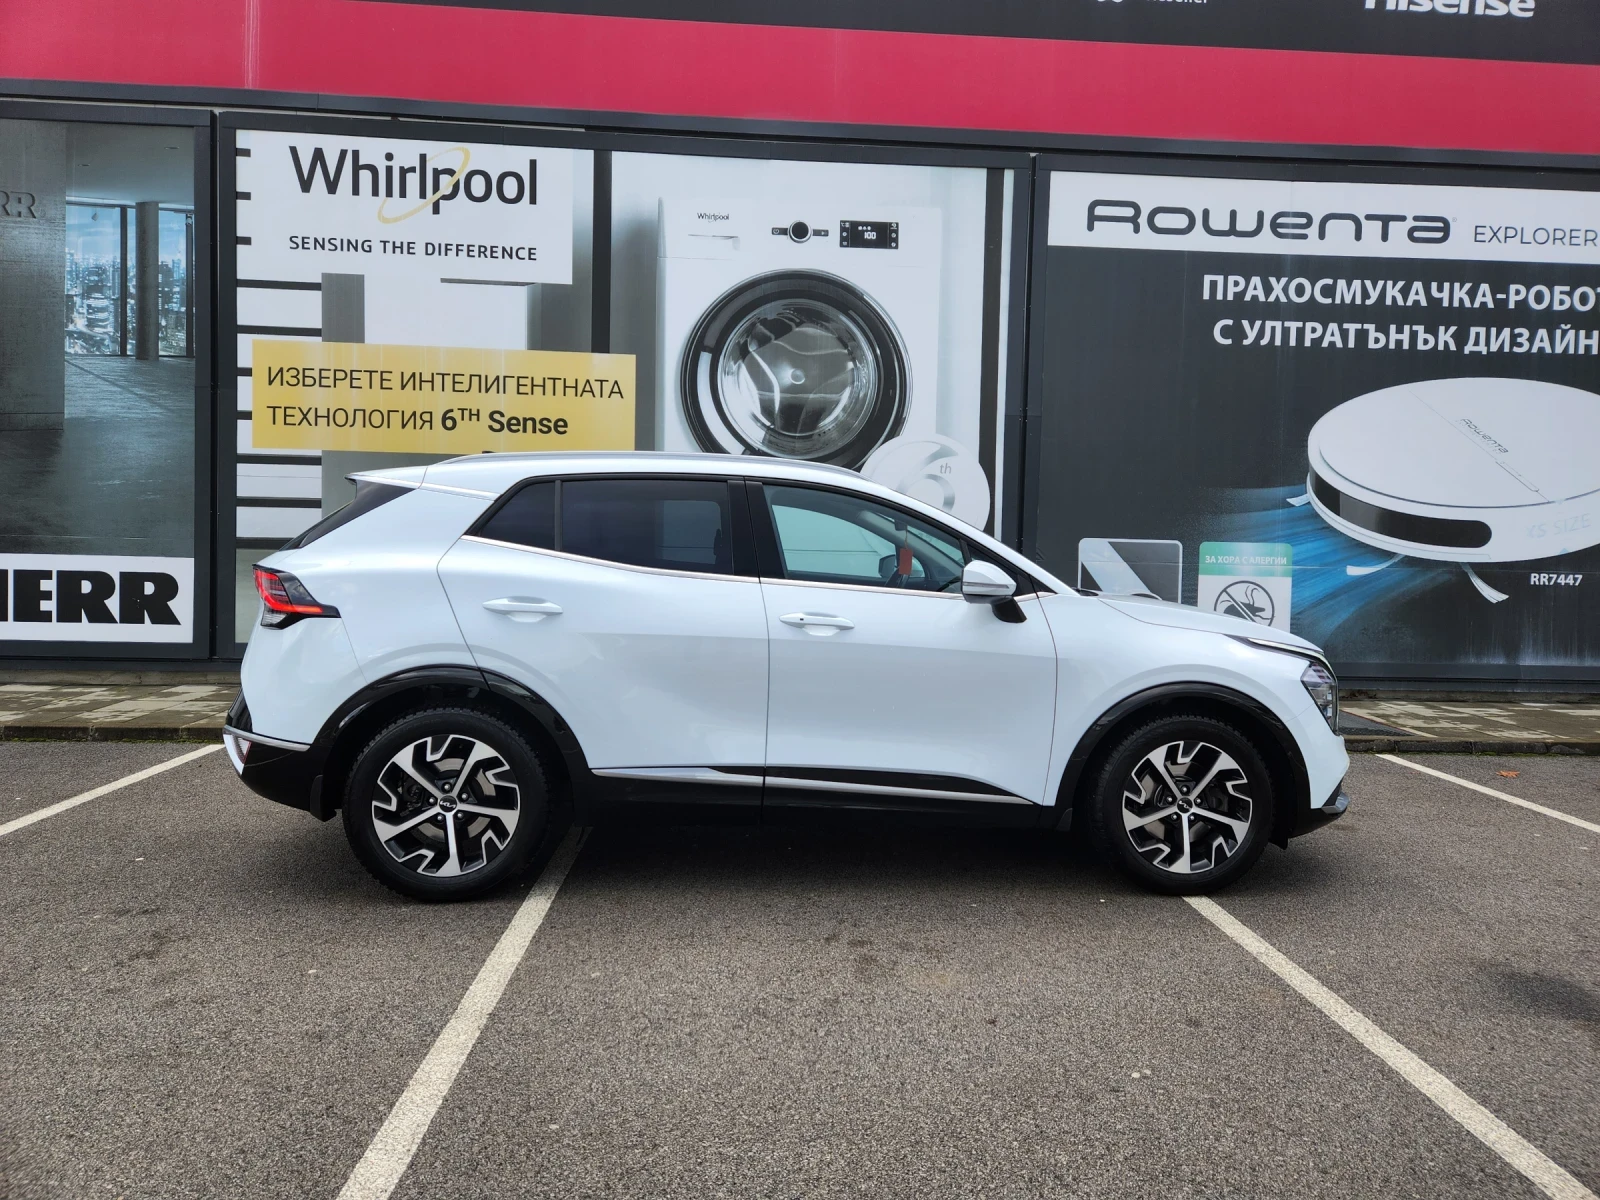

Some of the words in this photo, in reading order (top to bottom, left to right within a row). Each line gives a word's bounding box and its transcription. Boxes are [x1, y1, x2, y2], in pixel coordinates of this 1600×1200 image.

[288, 145, 538, 215] Whirlpool
[696, 212, 730, 222] Whirlpool
[1087, 199, 1451, 244] Rowenta
[1473, 225, 1598, 247] EXPLORER
[289, 235, 373, 253] SENSING
[379, 240, 416, 255] THE
[424, 242, 538, 261] DIFFERENCE
[1212, 319, 1234, 345] С
[1241, 319, 1458, 351] УЛТРАТЪНЪК
[1463, 323, 1599, 355] ДИЗАЙН
[266, 366, 394, 391] ИЗБЕРЕТЕ
[399, 371, 625, 400] ИНТЕЛИГЕНТНАТА
[266, 405, 434, 431] ТЕХНОЛОГИЯ
[487, 410, 569, 436] Sense
[1459, 418, 1509, 453] Rowenta
[1553, 513, 1592, 535] SIZE
[1205, 555, 1216, 564] ЗА
[1218, 556, 1240, 564] ХОРА
[1249, 556, 1287, 565] АЛЕРГИИ
[1530, 572, 1583, 586] RR7447
[0, 569, 182, 626] ERR
